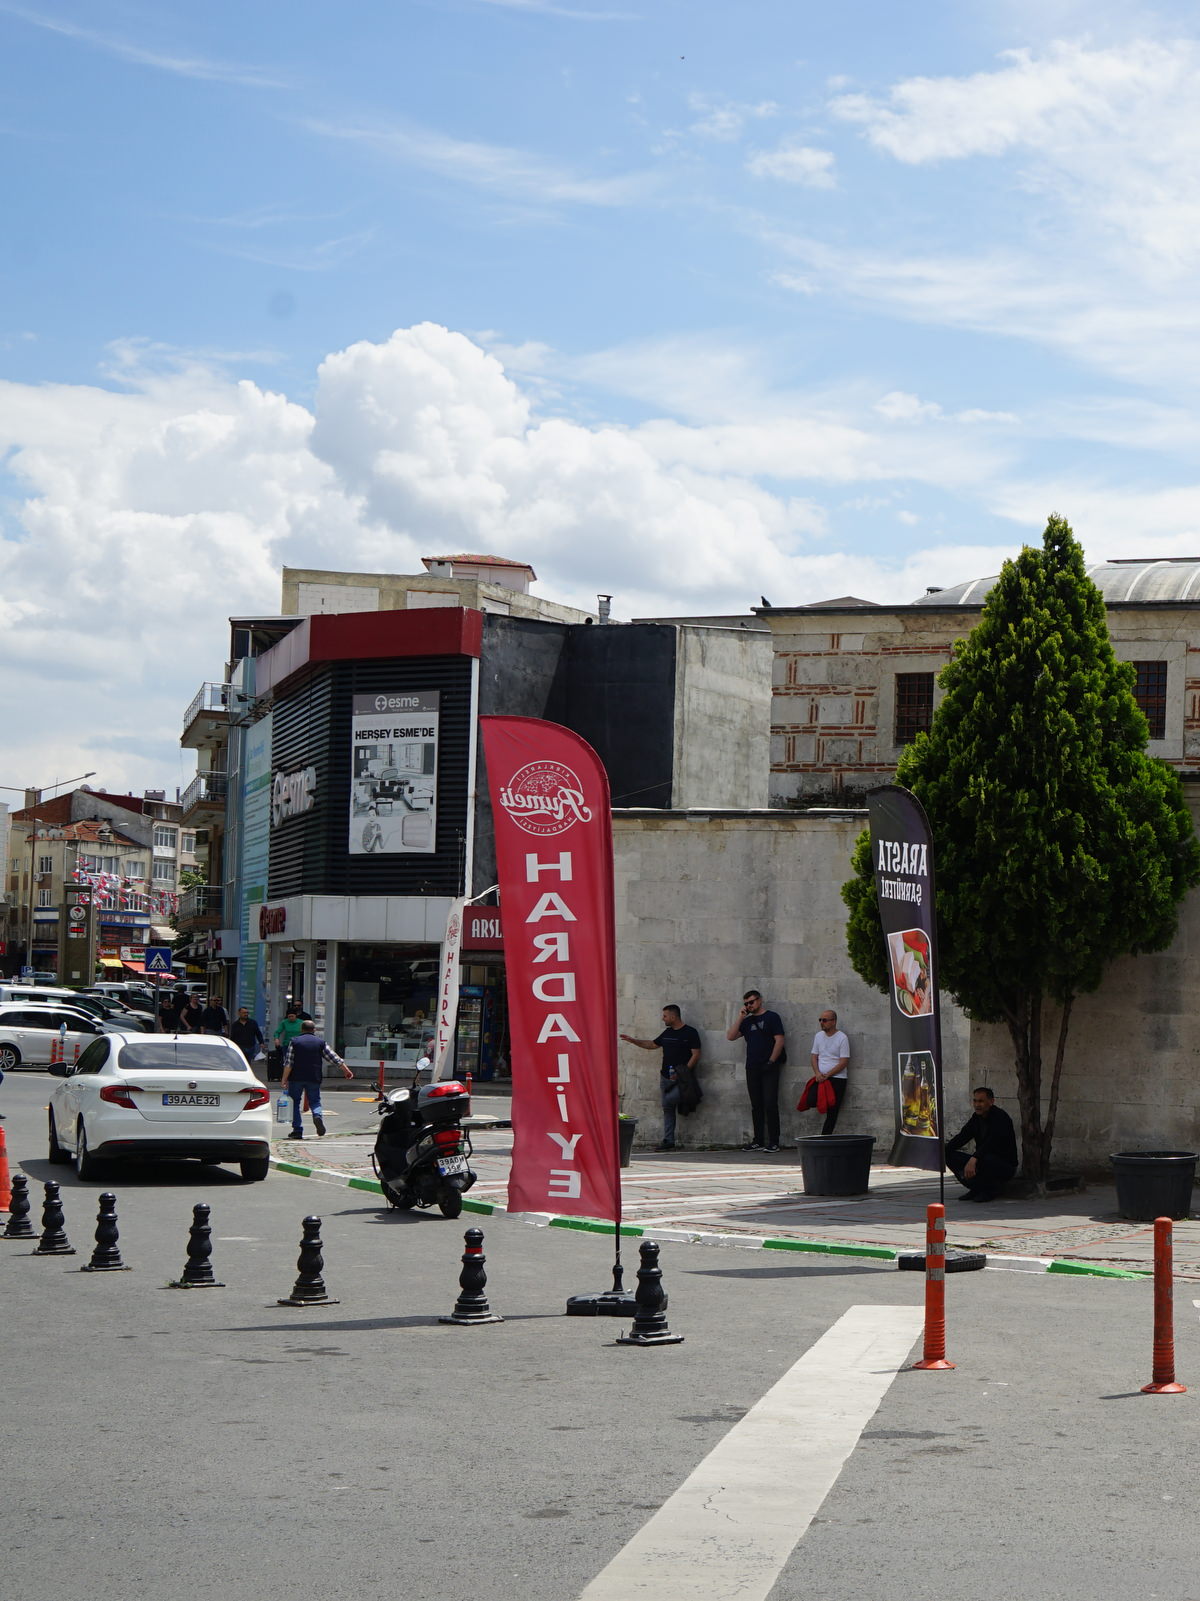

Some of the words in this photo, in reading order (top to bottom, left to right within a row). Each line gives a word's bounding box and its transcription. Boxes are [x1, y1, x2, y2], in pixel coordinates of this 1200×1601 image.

[388, 697, 419, 708] esme
[355, 729, 392, 741] HERŞEY
[393, 727, 435, 738] ESME'DE
[471, 918, 504, 938] ARSL
